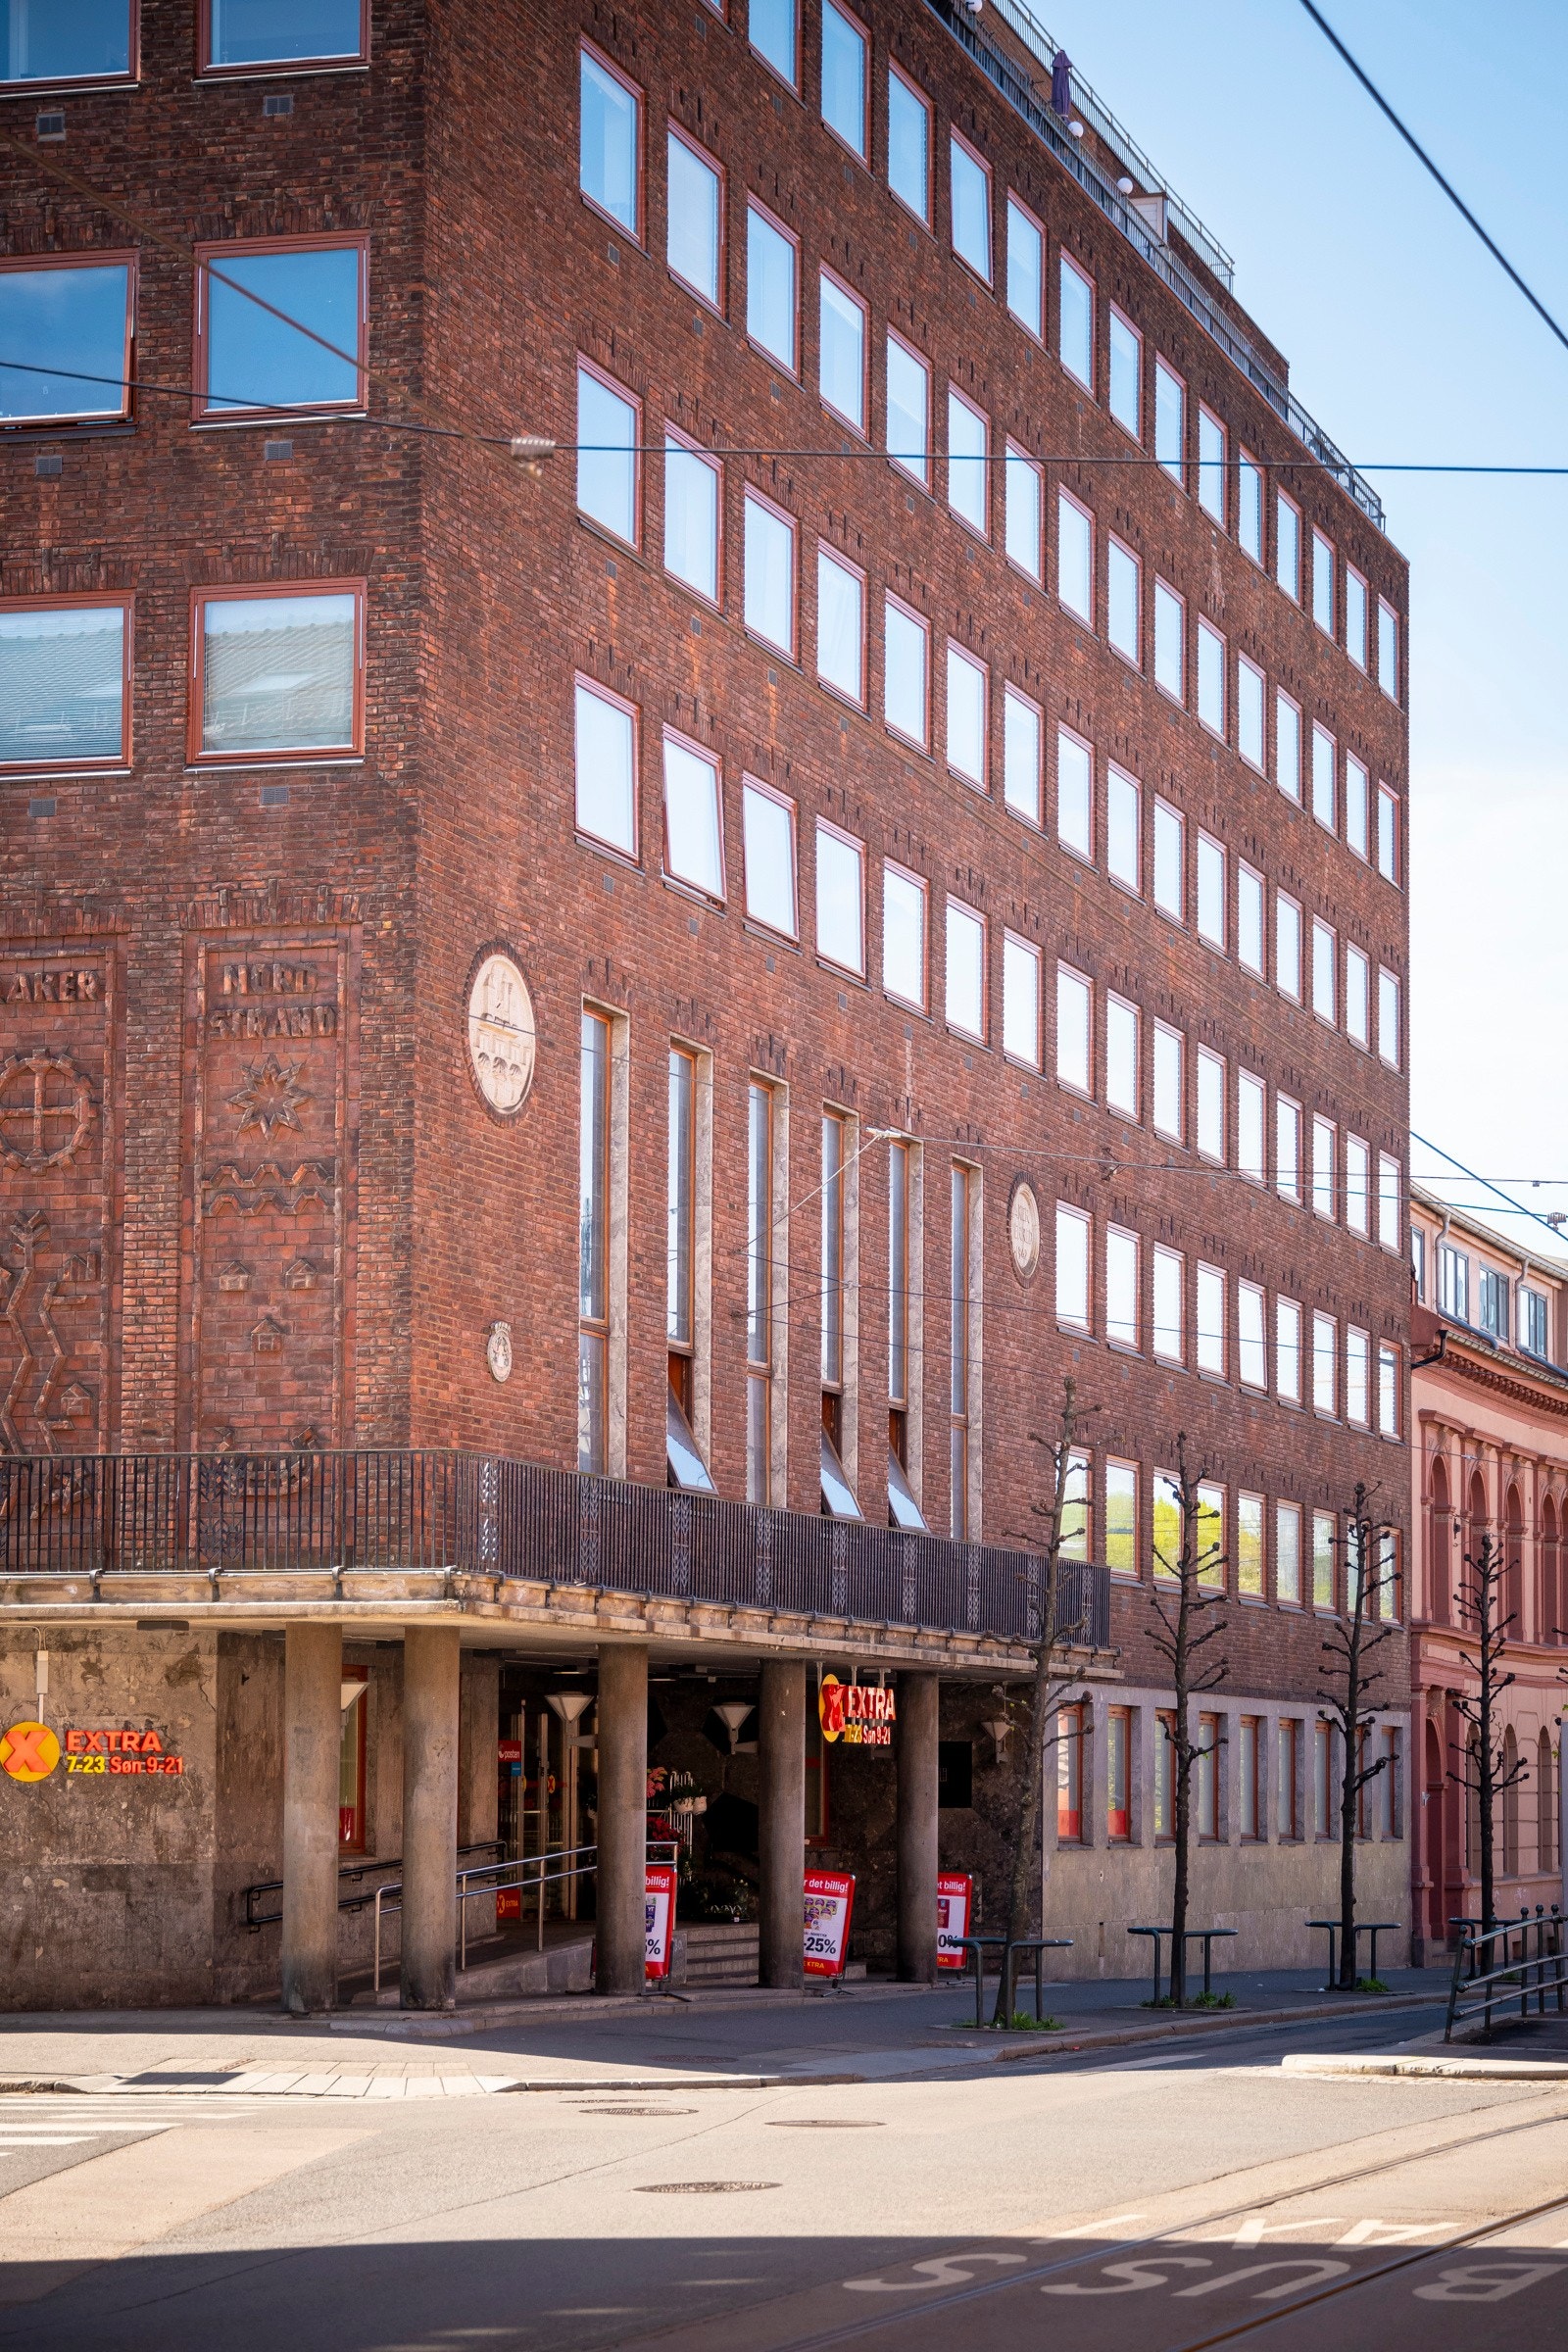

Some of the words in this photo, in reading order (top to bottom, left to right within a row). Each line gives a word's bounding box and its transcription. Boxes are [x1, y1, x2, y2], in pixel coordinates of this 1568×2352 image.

[223, 962, 319, 995] NORD
[210, 1005, 338, 1039] STRAND
[846, 1685, 897, 1721] EXTRA
[66, 1730, 163, 1752] EXTRA
[67, 1755, 106, 1774] 7-23
[110, 1755, 142, 1775] Søn
[147, 1756, 183, 1775] 9-21
[646, 1876, 669, 1887] billig!
[808, 1879, 823, 1888] det
[824, 1880, 849, 1893] billig!
[944, 1881, 966, 1892] billig!
[804, 1936, 836, 1955] -25%
[842, 2253, 1568, 2302] BUSS
